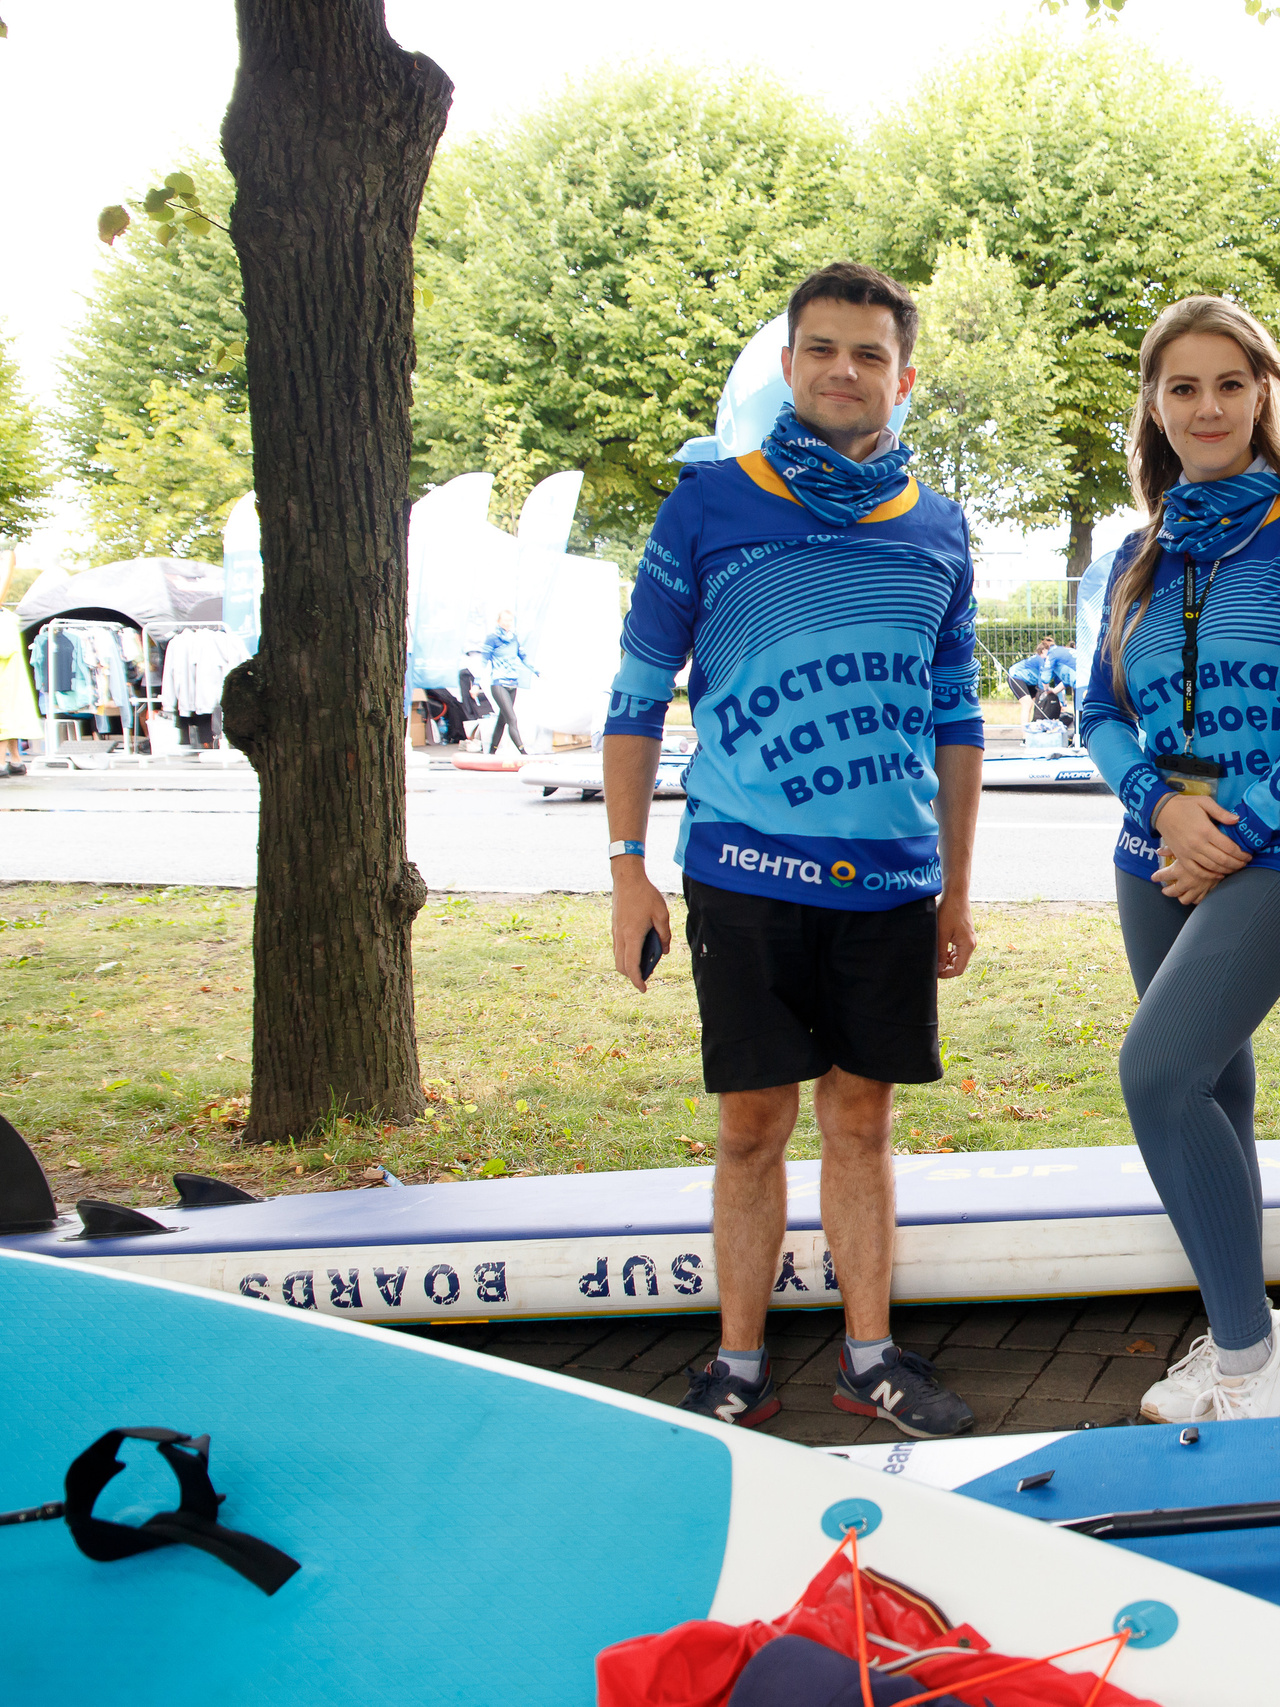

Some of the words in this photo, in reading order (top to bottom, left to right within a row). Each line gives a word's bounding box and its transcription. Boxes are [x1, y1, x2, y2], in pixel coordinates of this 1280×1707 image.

[760, 720, 826, 773] на
[780, 750, 925, 809] волне
[718, 843, 823, 885] лента
[862, 857, 942, 892] онлайн
[238, 1260, 510, 1310] BOARDS
[578, 1253, 704, 1298] SUP
[869, 1379, 905, 1412] N
